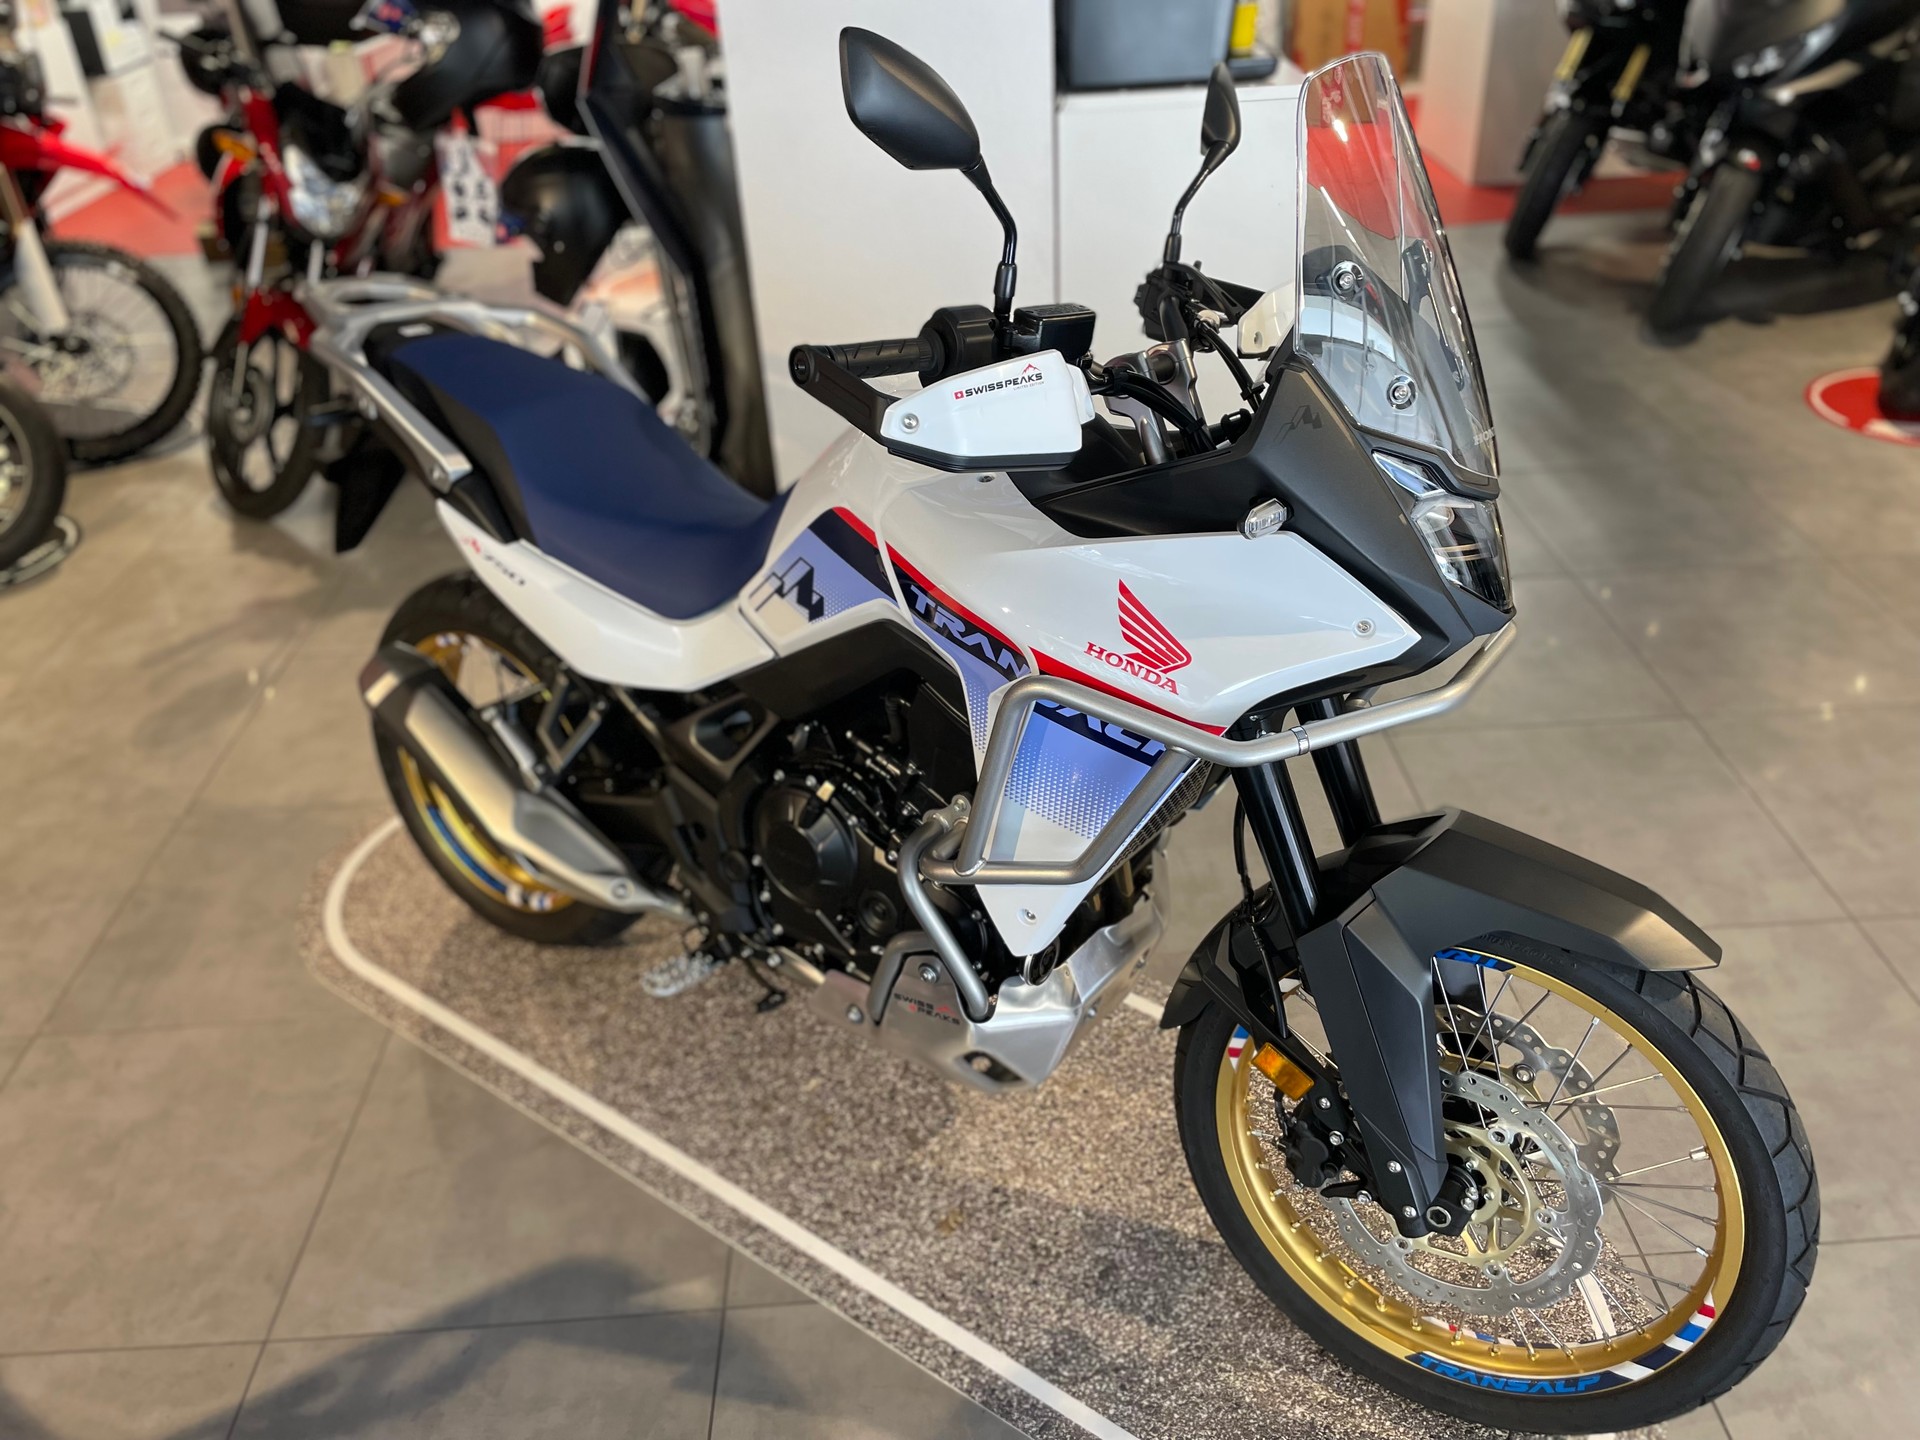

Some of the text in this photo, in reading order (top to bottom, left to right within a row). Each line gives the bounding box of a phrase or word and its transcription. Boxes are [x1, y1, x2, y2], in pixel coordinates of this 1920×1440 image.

[1083, 641, 1180, 696] HONDA
[894, 993, 934, 1010] SWISS
[1418, 1353, 1602, 1394] TRANSALP
